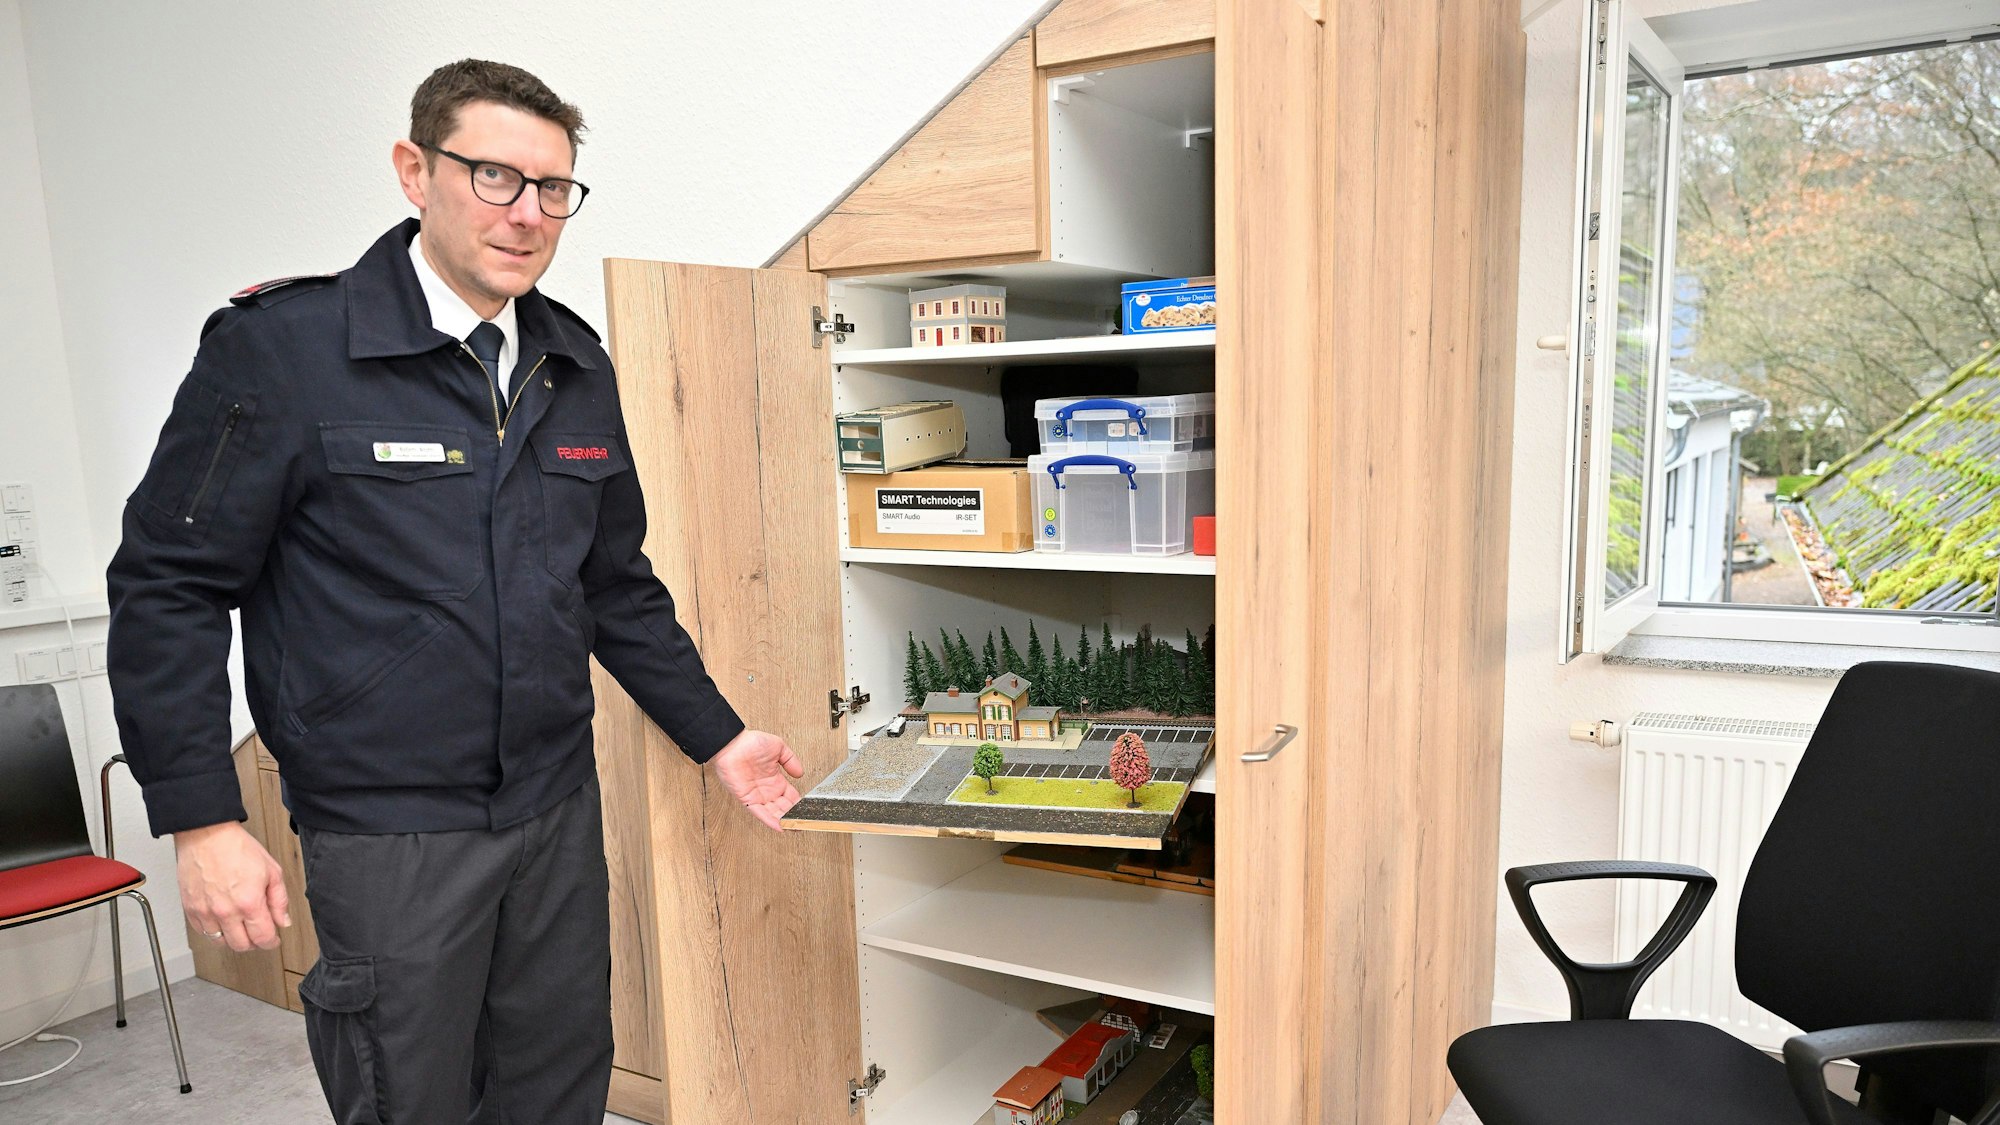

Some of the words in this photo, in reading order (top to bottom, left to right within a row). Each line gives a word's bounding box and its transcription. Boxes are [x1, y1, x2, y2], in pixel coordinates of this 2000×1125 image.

[557, 447, 609, 460] FEUERWEHR
[881, 494, 914, 505] SMART
[915, 495, 977, 507] Technologies
[882, 512, 903, 520] SMART
